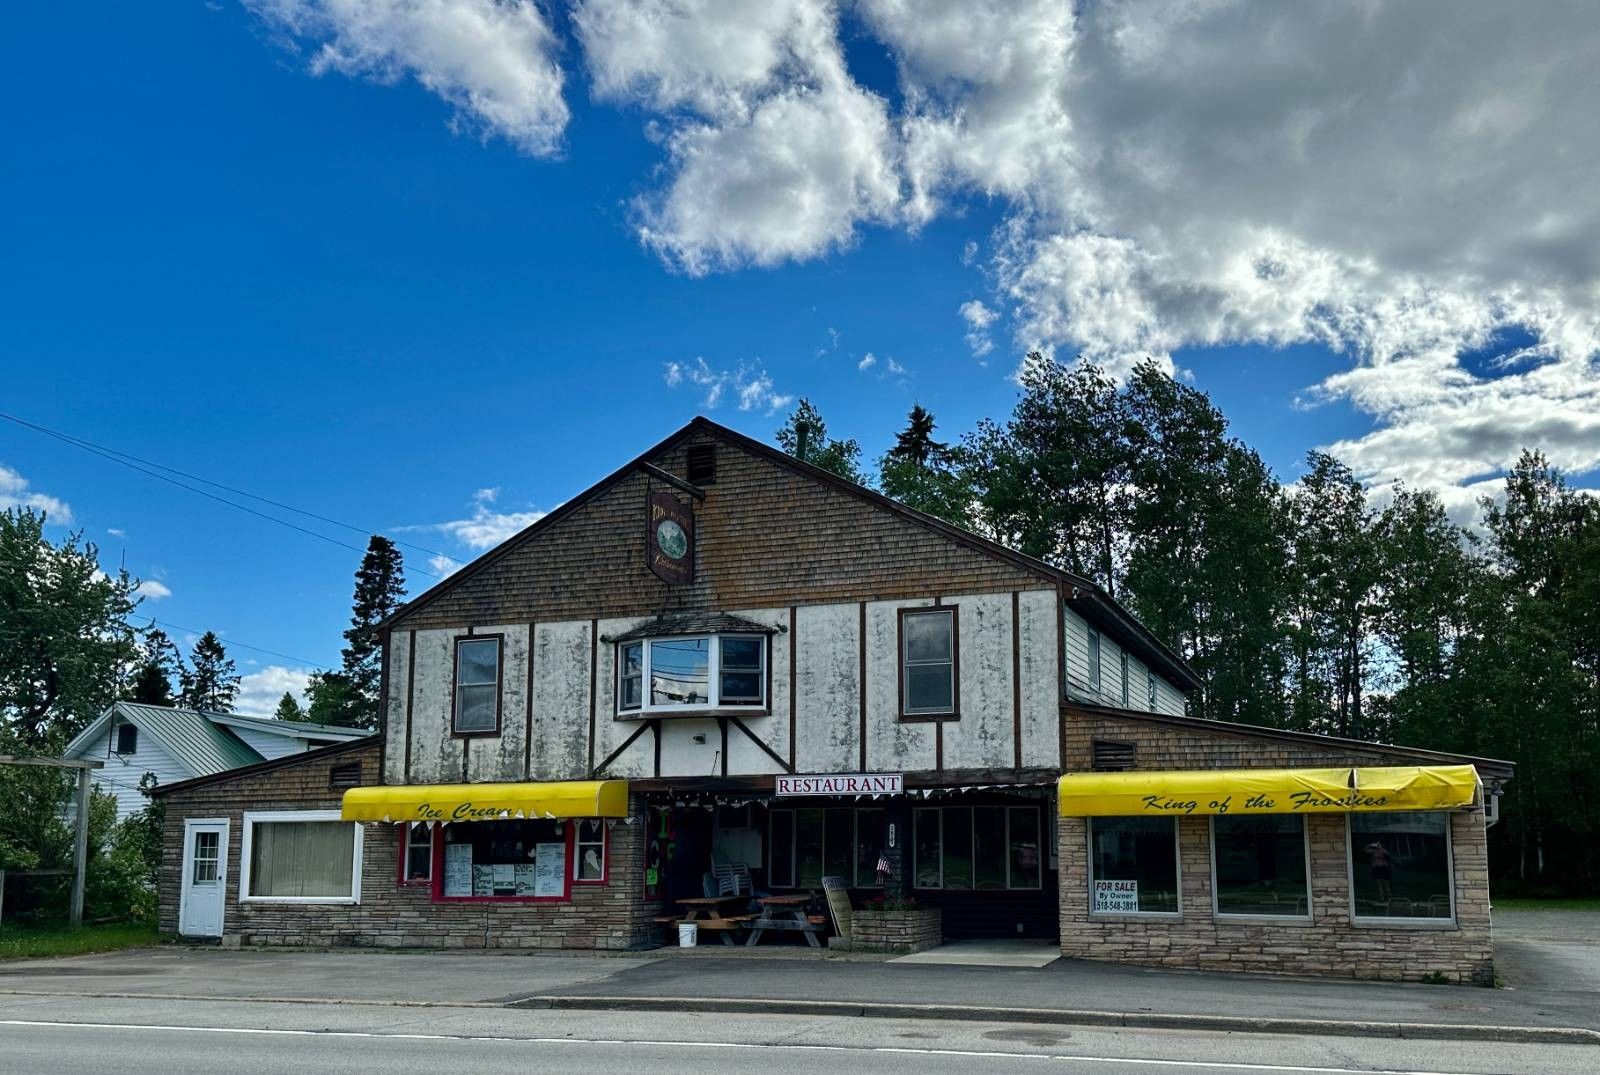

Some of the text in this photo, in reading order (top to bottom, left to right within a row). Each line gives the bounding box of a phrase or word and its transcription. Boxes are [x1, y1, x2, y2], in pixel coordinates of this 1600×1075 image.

[778, 777, 900, 793] RESTAURANT
[1142, 791, 1390, 814] King of the Frosties
[417, 803, 444, 818] Ice
[1096, 881, 1136, 892] FOR SALE
[1099, 892, 1108, 900] By
